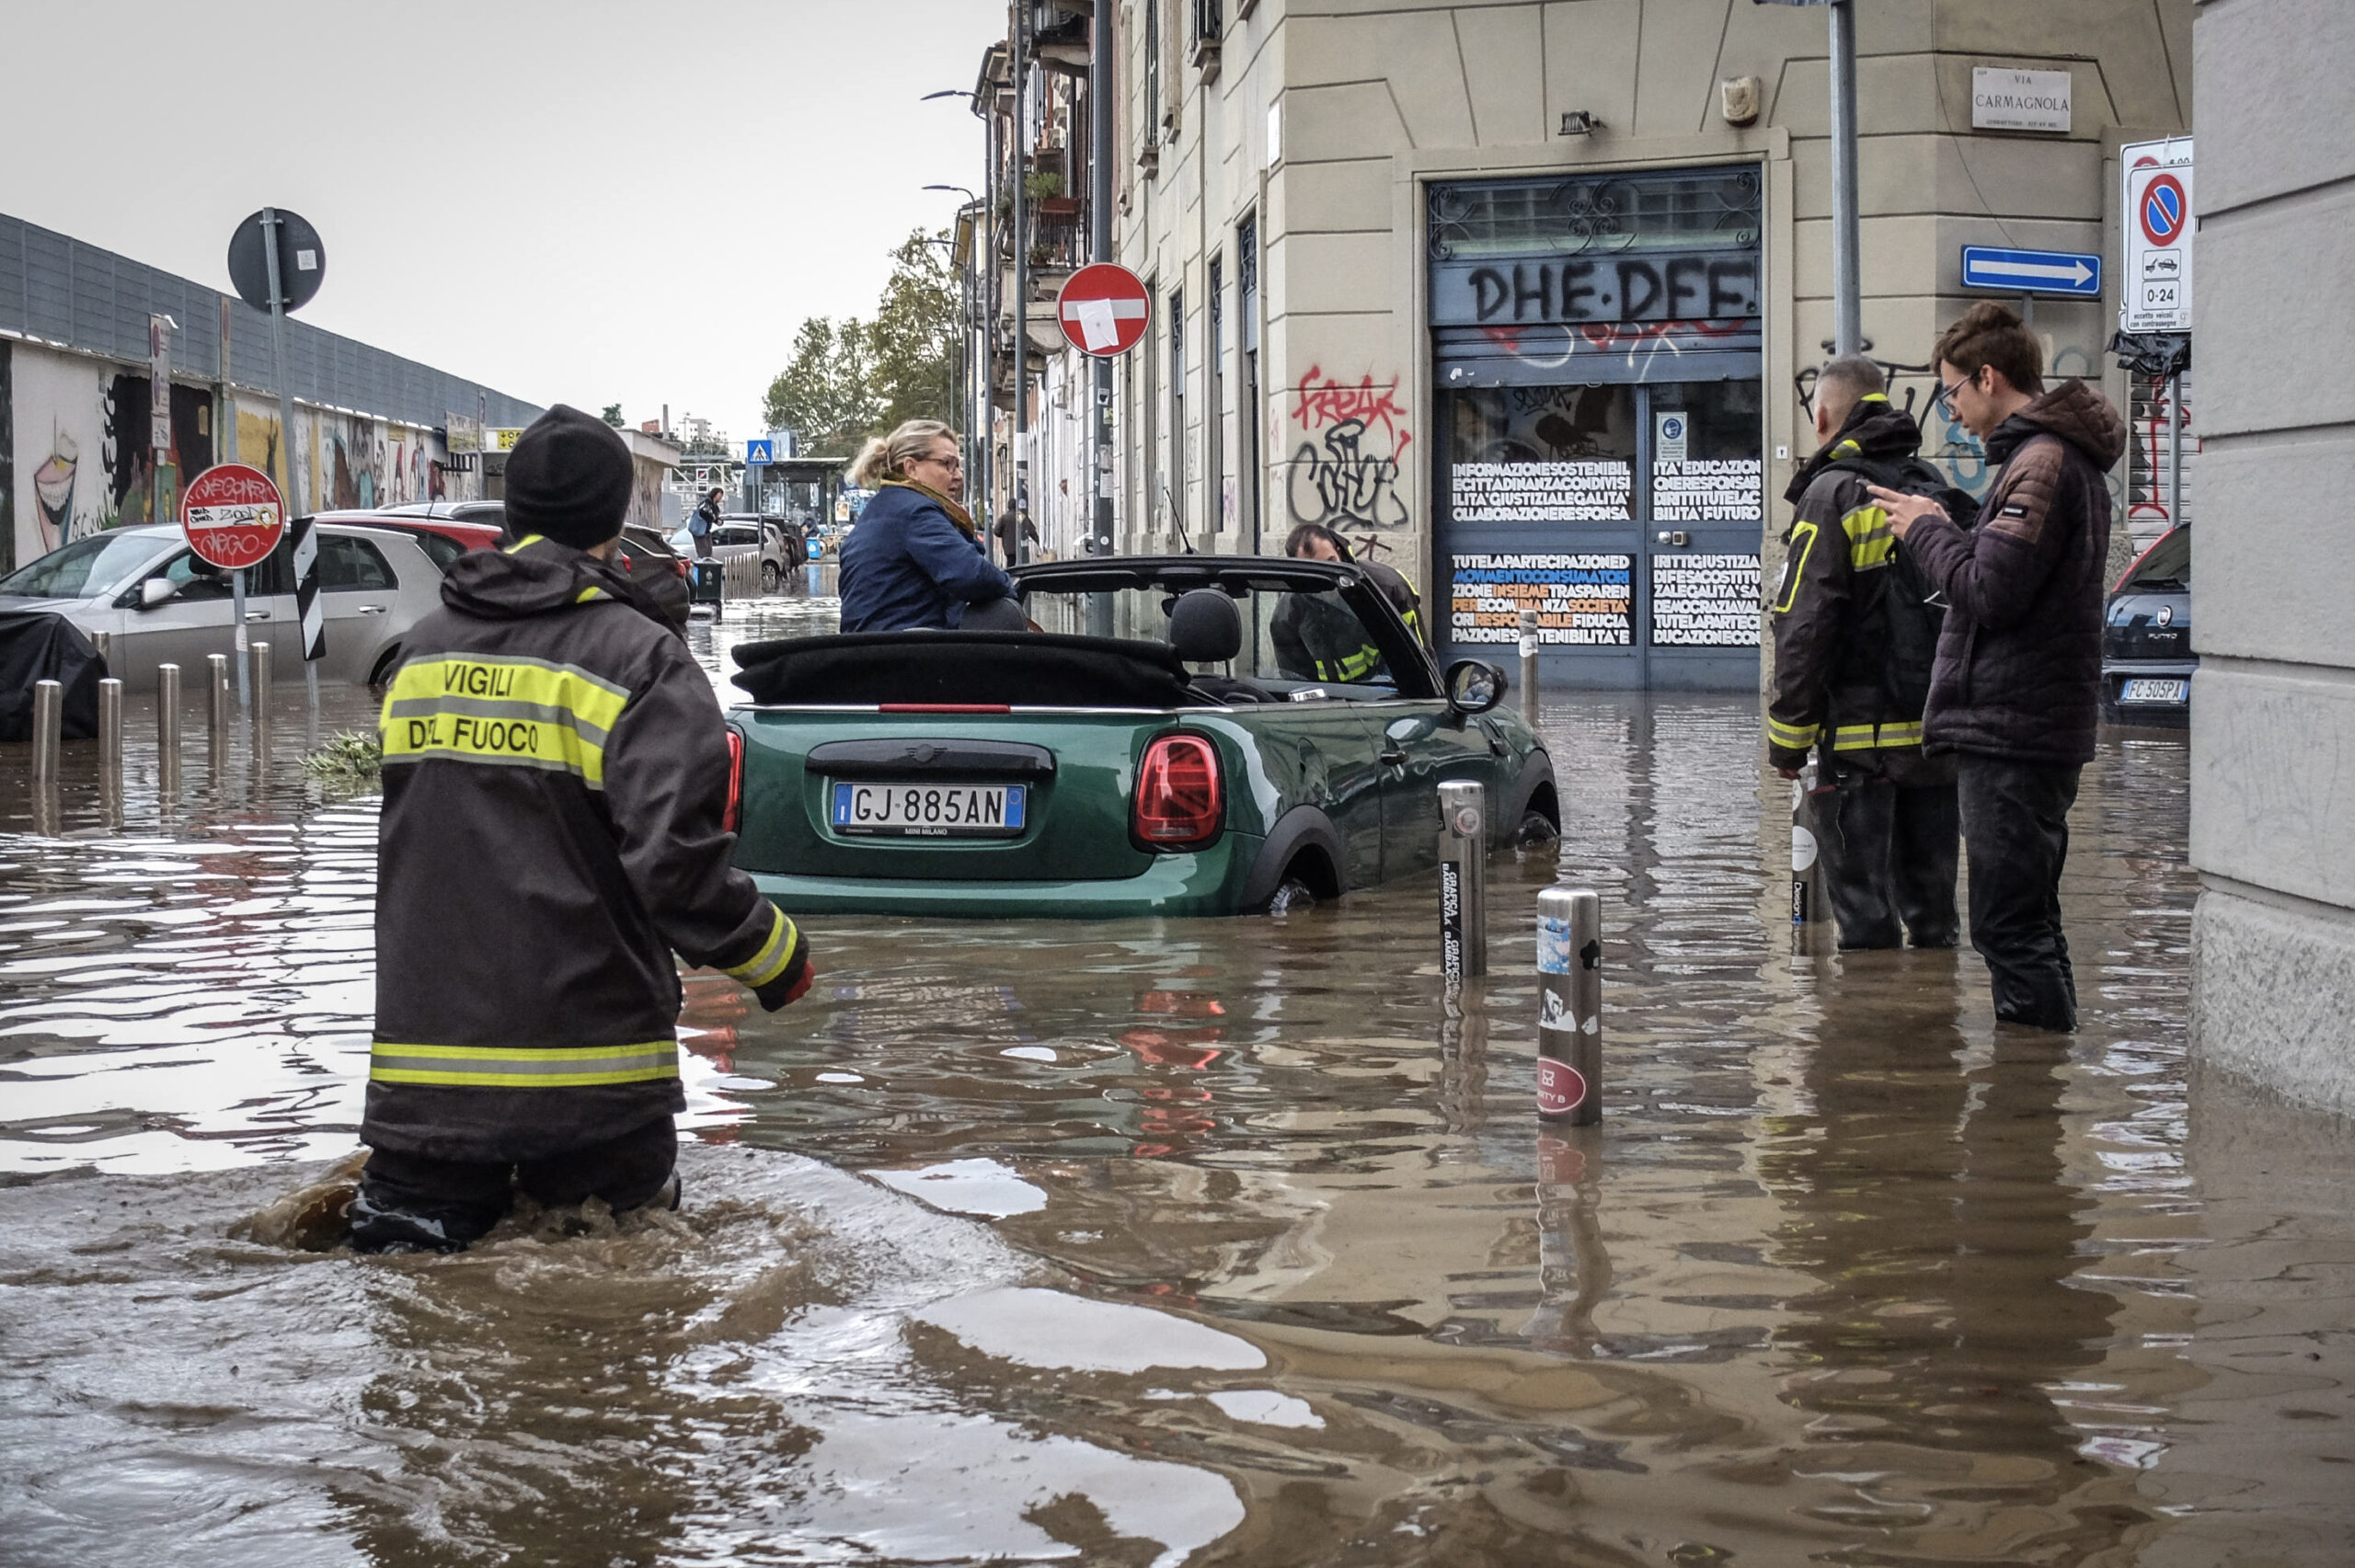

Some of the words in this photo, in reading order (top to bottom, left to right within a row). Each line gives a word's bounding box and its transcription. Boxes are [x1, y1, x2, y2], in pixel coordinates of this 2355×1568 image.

[2015, 74, 2031, 85] VIA
[1975, 94, 2070, 111] CARMAGNOLA
[2147, 289, 2175, 303] 0-24
[1453, 462, 1630, 476] INFORMAZIONESOSTENIBIL
[1453, 476, 1630, 491] ECITTADINANZACONDIVISI
[1654, 475, 1761, 491] ONERESPONSAB
[1453, 507, 1630, 521] OLLABORAZIONERESPONSA
[1452, 555, 1630, 568] TUTELAPARTECIPAZIONED
[1653, 569, 1761, 584] DIFESACOSTITU
[1653, 600, 1761, 613] DEMOCRAZIAVAL
[444, 663, 515, 697] VIGILI
[2129, 681, 2144, 698] FC
[2146, 681, 2180, 699] 505PA
[453, 717, 538, 753] FUOCO
[856, 789, 891, 821] GJ
[904, 789, 1003, 824] 885AN
[1448, 872, 1458, 917] GRAFICA
